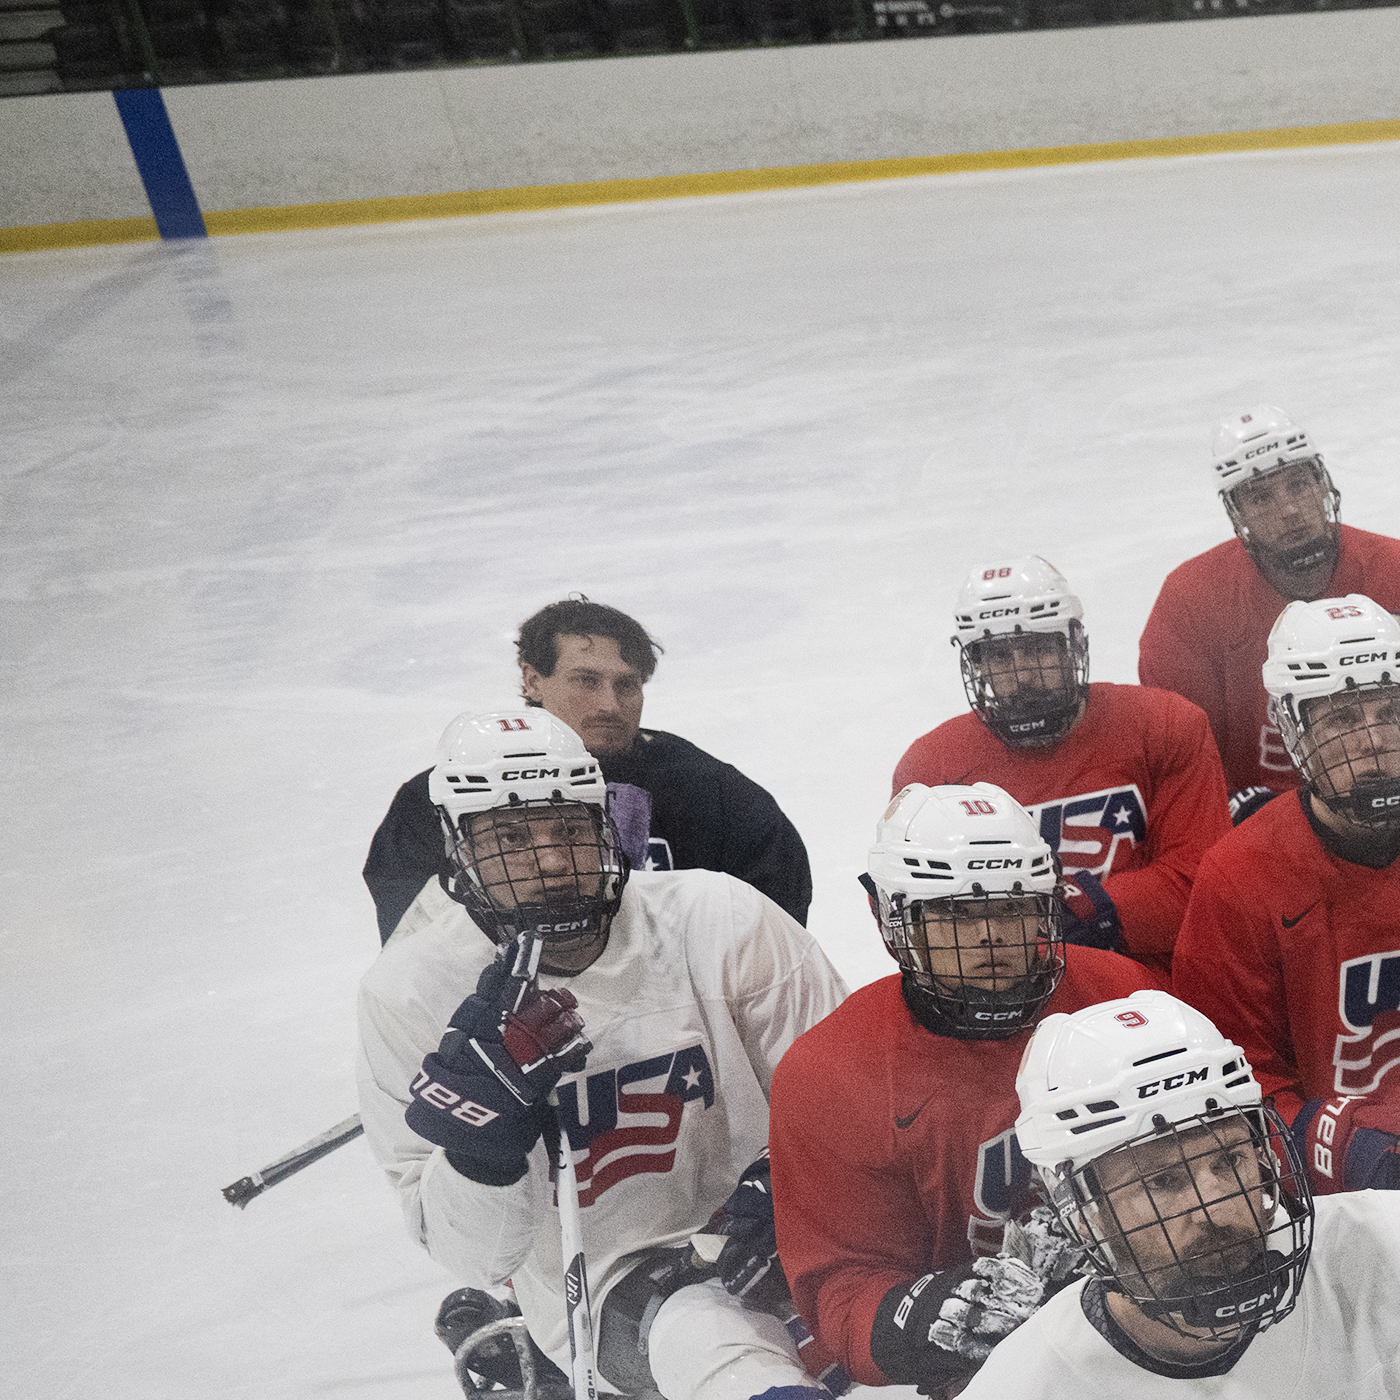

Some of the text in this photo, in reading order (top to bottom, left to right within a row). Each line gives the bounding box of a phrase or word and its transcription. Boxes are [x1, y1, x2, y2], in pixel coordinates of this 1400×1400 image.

[1245, 442, 1279, 460] CCM
[982, 566, 1012, 581] 88
[979, 607, 1020, 620] CCM
[1339, 651, 1388, 667] CCM
[497, 717, 532, 732] 11
[501, 767, 560, 781] CCM
[959, 799, 998, 816] 10
[967, 858, 1023, 871] CCM
[536, 919, 588, 933] CCM
[974, 1010, 1023, 1022] CCM
[1114, 1010, 1150, 1030] 9
[1136, 1066, 1209, 1099] CCM
[556, 1044, 715, 1185] USA
[1060, 1201, 1077, 1218] CCM
